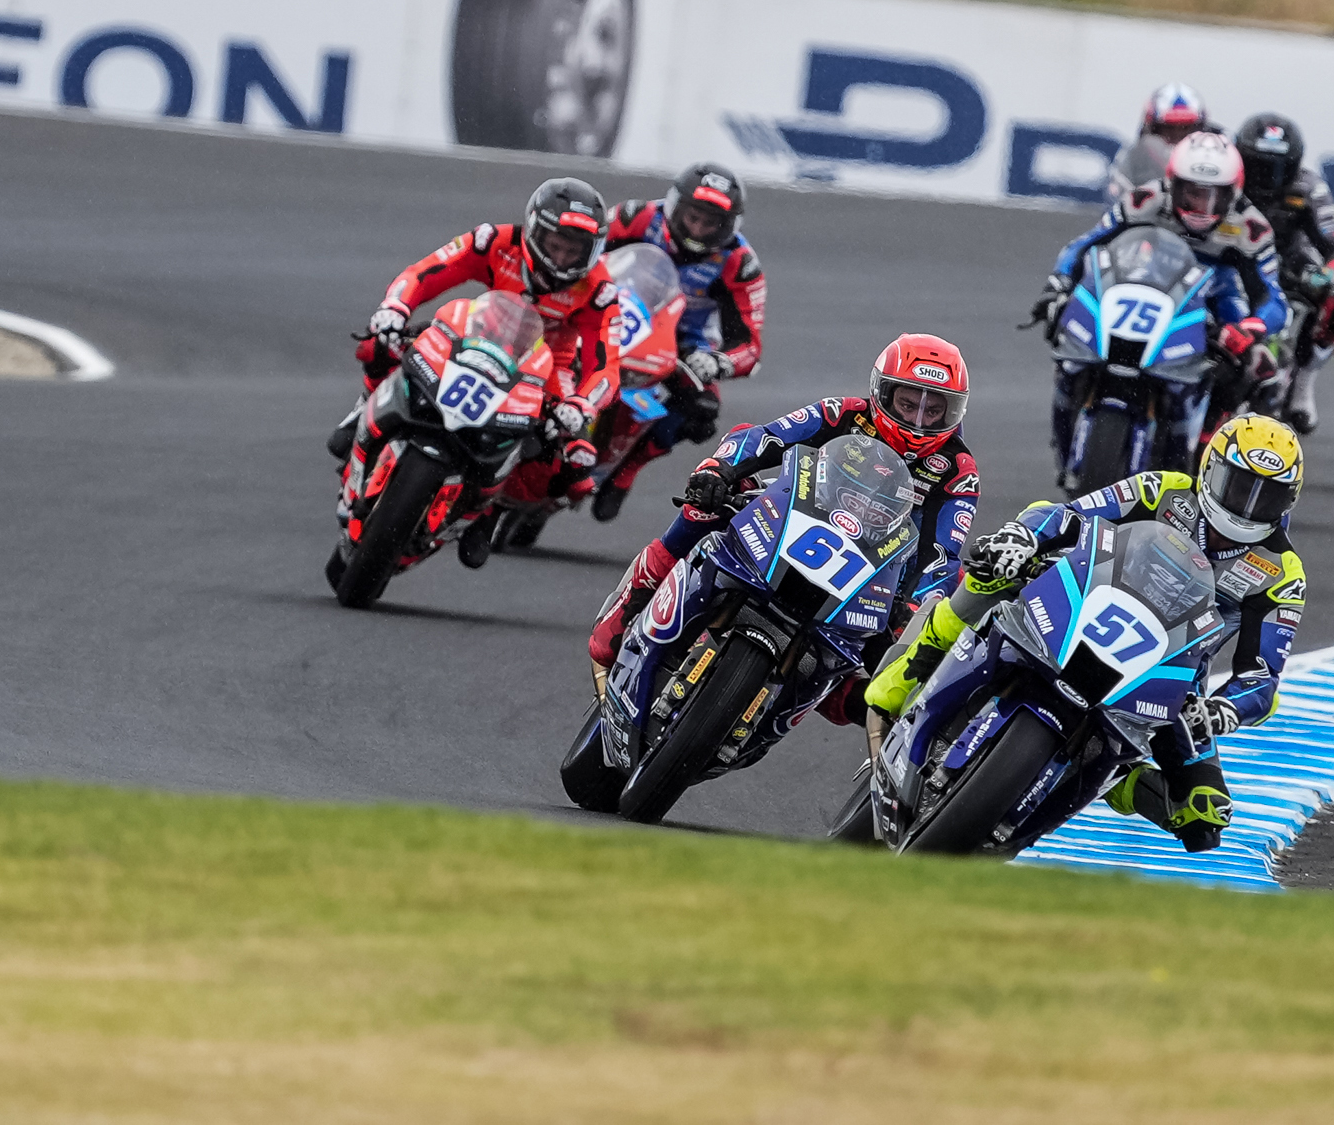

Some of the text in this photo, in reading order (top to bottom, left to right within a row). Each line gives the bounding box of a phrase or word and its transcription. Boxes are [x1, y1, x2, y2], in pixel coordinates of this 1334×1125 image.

[1111, 299, 1161, 334] 75
[919, 366, 945, 380] SHOEI
[440, 374, 495, 422] 65
[1252, 451, 1281, 468] Arai
[836, 515, 856, 533] PATA
[1169, 516, 1193, 538] ENEOS
[1198, 518, 1207, 551] YAMAHA
[739, 523, 768, 561] YAMAHA
[787, 525, 868, 592] 61
[1241, 565, 1265, 582] YAMAHA
[845, 610, 878, 630] YAMAHA
[1028, 596, 1054, 635] YAMAHA
[746, 630, 776, 656] YAMAHA
[1082, 603, 1160, 665] 57
[1037, 707, 1063, 731] YAMAHA
[1136, 700, 1168, 719] YAMAHA
[965, 711, 999, 757] PIRELLI
[1017, 768, 1054, 812] PIRELLI
